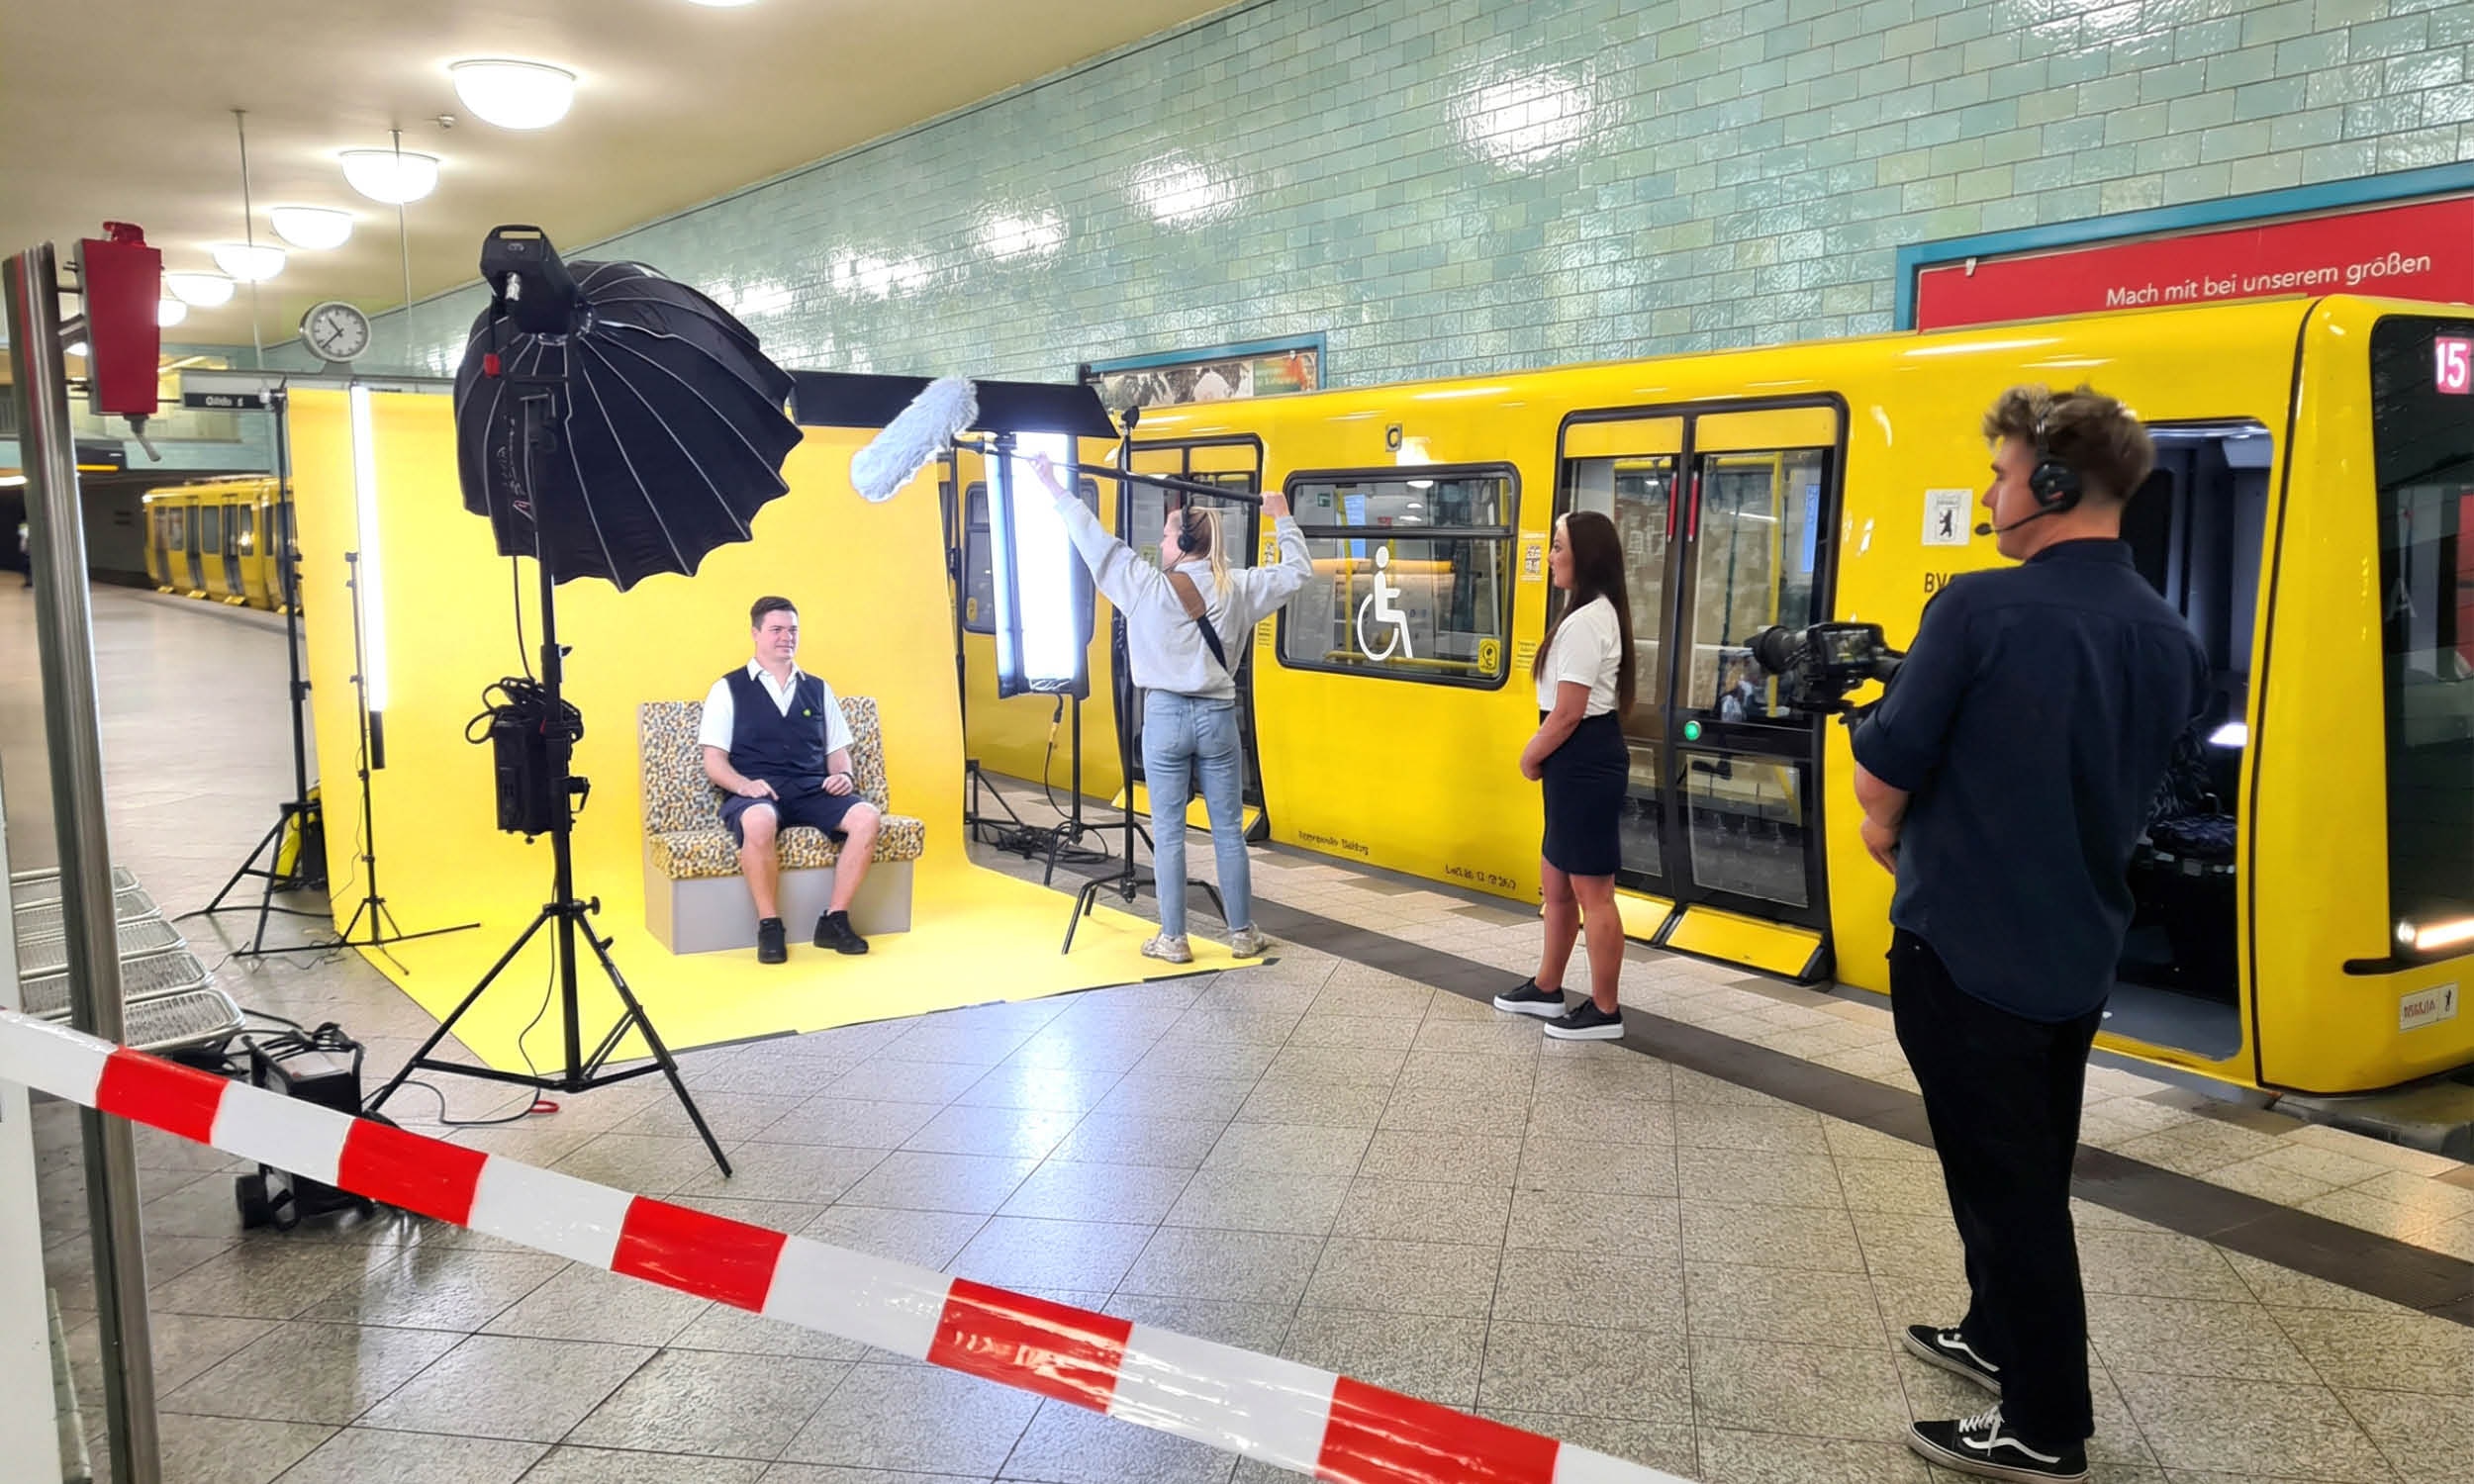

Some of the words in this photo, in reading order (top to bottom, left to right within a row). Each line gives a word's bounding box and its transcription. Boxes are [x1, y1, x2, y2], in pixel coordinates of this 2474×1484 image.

[2106, 282, 2159, 307] Mach
[2164, 279, 2199, 301] mit
[2204, 274, 2237, 297] bei
[2243, 266, 2338, 293] unserem
[2346, 251, 2431, 286] größen
[2437, 342, 2466, 388] 15
[1386, 426, 1399, 448] C
[1924, 572, 1952, 594] BV
